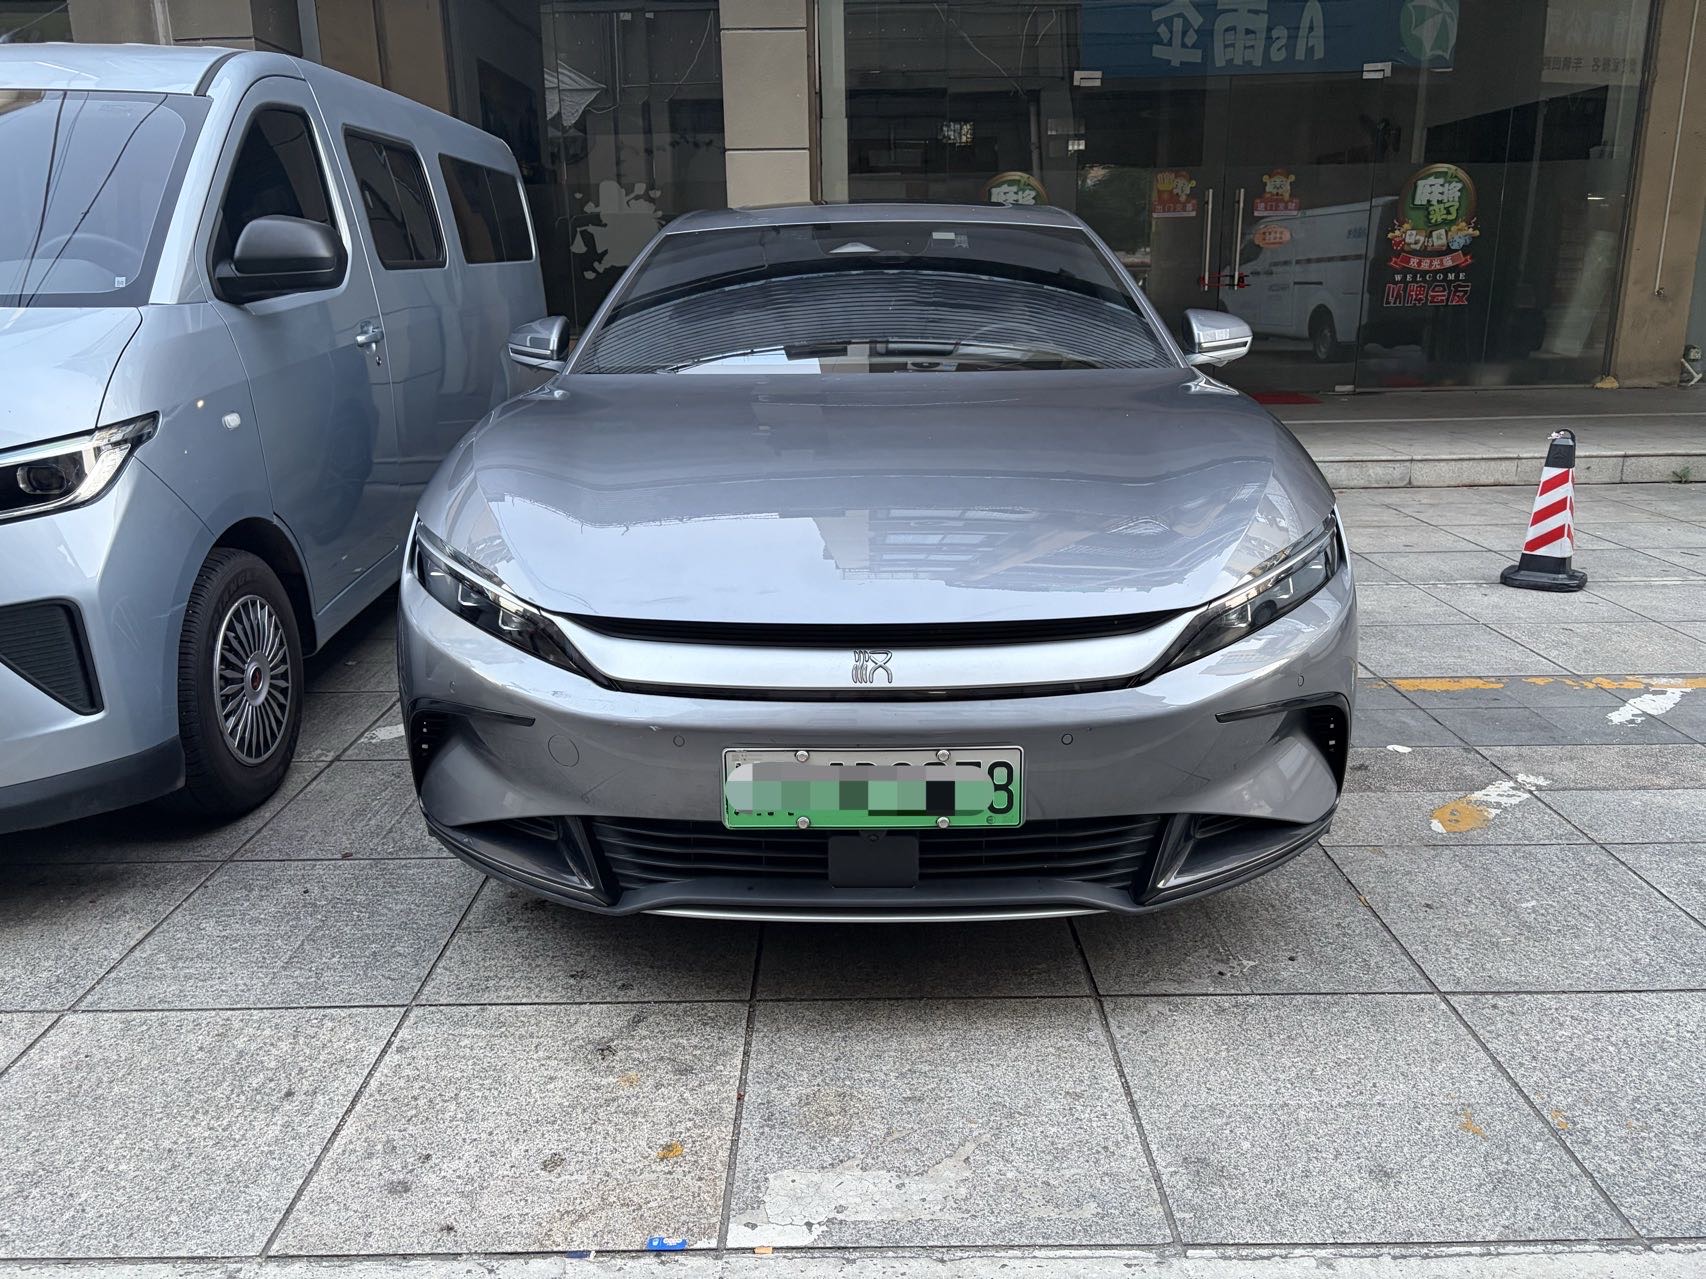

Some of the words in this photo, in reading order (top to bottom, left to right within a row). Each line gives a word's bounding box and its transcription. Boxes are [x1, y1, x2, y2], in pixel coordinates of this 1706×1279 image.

[1414, 177, 1463, 205] 麻将
[1409, 255, 1453, 269] 欢迎光临
[1394, 272, 1466, 282] WELCOME
[1384, 283, 1471, 306] 以牌会友
